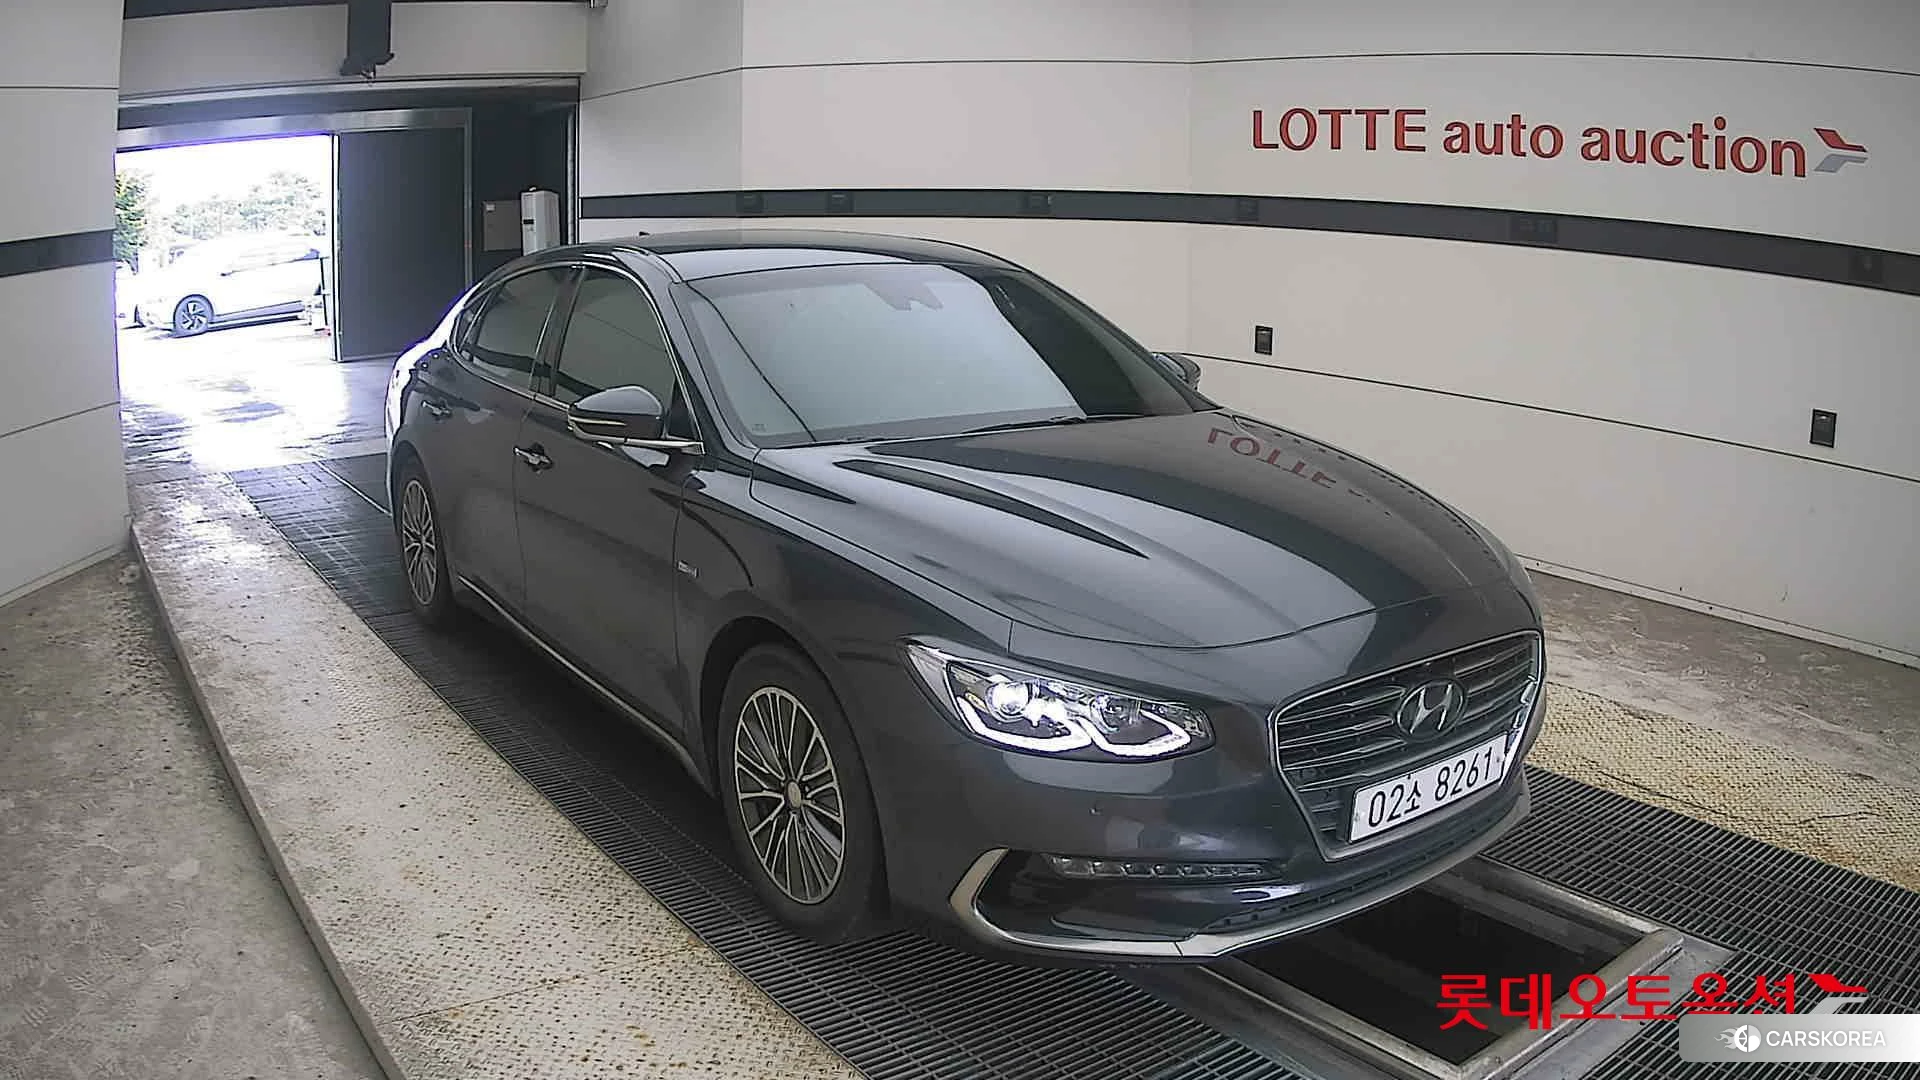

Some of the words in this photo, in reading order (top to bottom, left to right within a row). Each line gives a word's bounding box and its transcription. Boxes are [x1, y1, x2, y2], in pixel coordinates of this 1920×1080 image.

[1252, 108, 1427, 152] LOTTE
[1443, 114, 1564, 158] auto
[1580, 117, 1807, 178] auction
[1368, 781, 1421, 827] 02소
[1435, 748, 1493, 801] 8261
